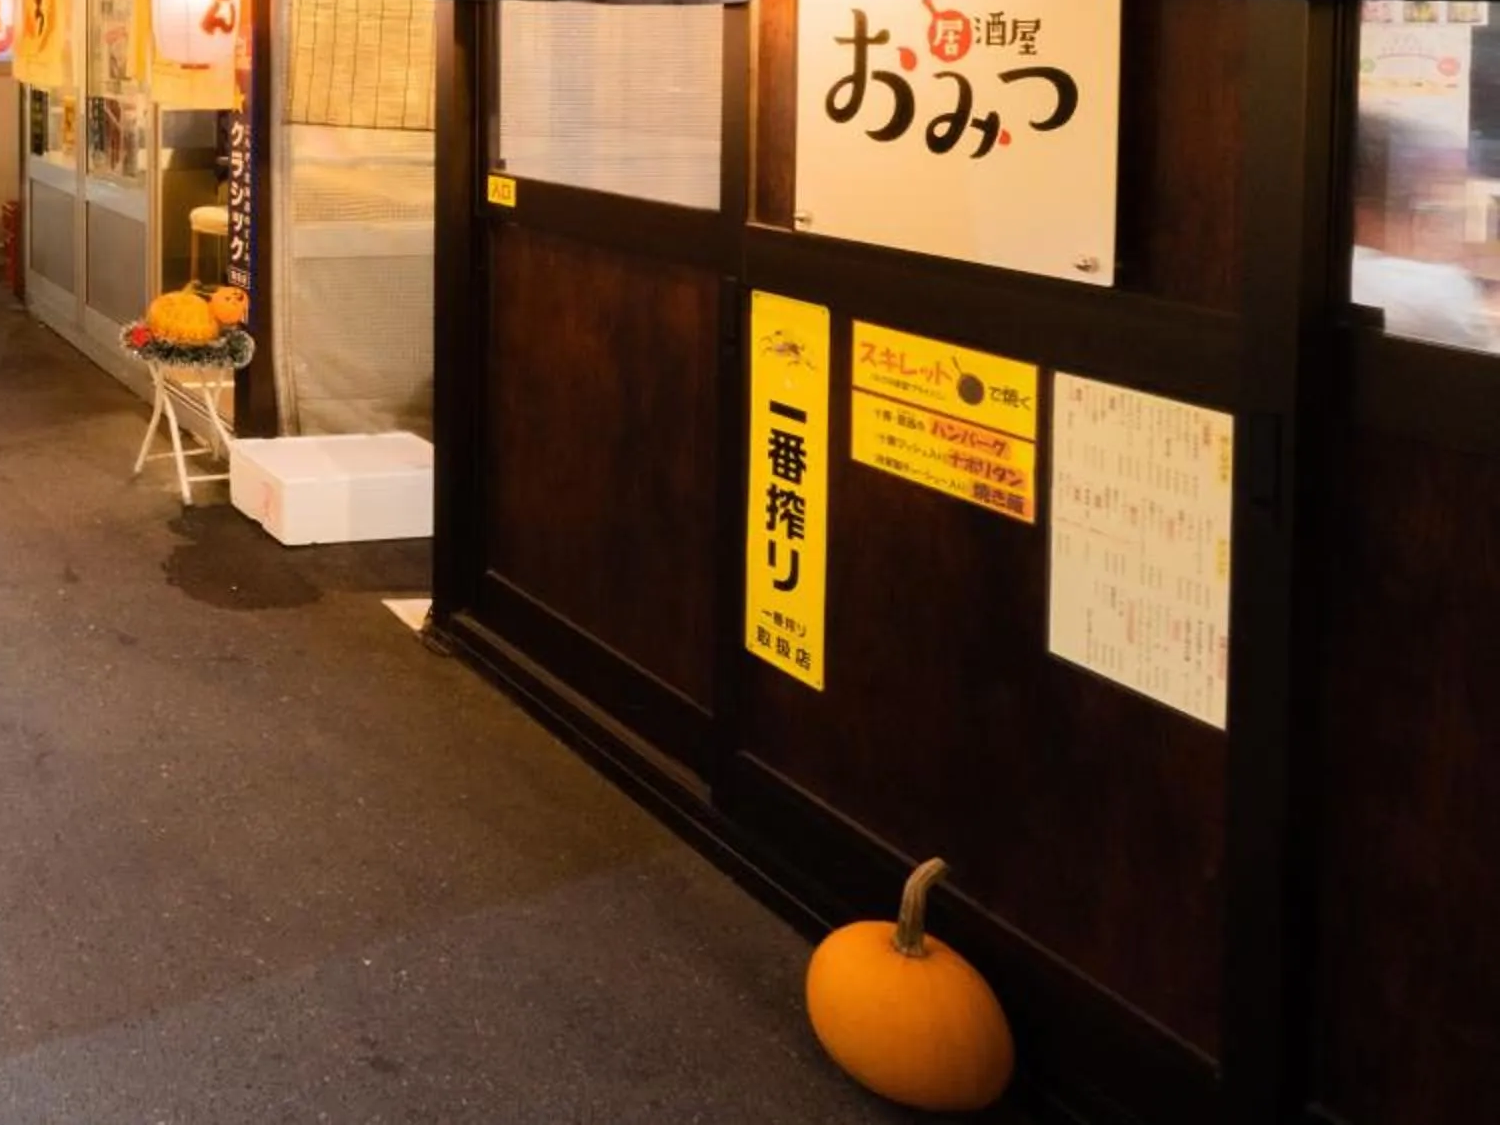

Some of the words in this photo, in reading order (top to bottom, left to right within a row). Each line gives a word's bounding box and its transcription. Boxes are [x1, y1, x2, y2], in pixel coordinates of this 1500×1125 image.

[932, 11, 1041, 56] 居酒屋
[825, 9, 1079, 159] おみつ
[229, 121, 245, 261] クラシック
[859, 340, 953, 386] スキレット
[988, 385, 1032, 411] で焼く
[930, 420, 1008, 459] ハンバーグ
[948, 452, 1024, 488] ナポリタン
[766, 399, 808, 592] 一番搾り
[756, 624, 812, 672] 取扱店
